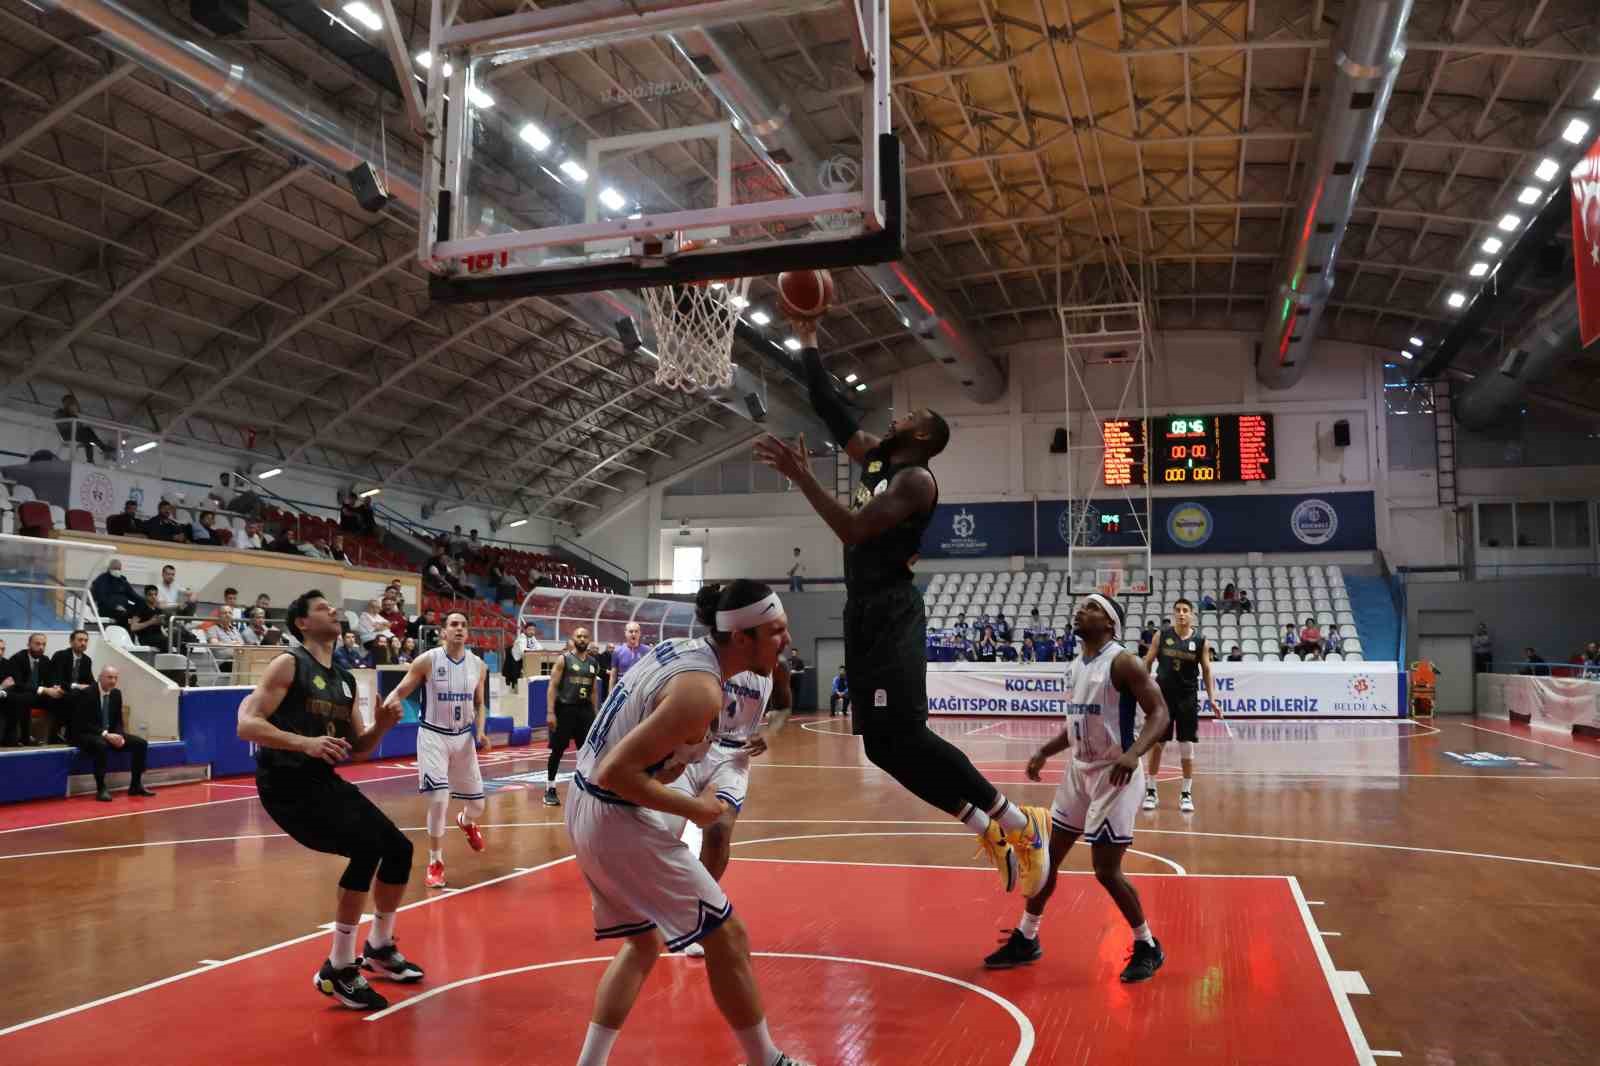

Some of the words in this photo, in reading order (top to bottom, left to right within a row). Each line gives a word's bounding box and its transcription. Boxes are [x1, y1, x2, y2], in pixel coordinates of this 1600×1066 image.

[579, 687, 587, 699] 5
[929, 696, 1007, 712] KAĞITSPOR
[1260, 695, 1319, 713] DİLERİZ
[454, 706, 461, 721] 6
